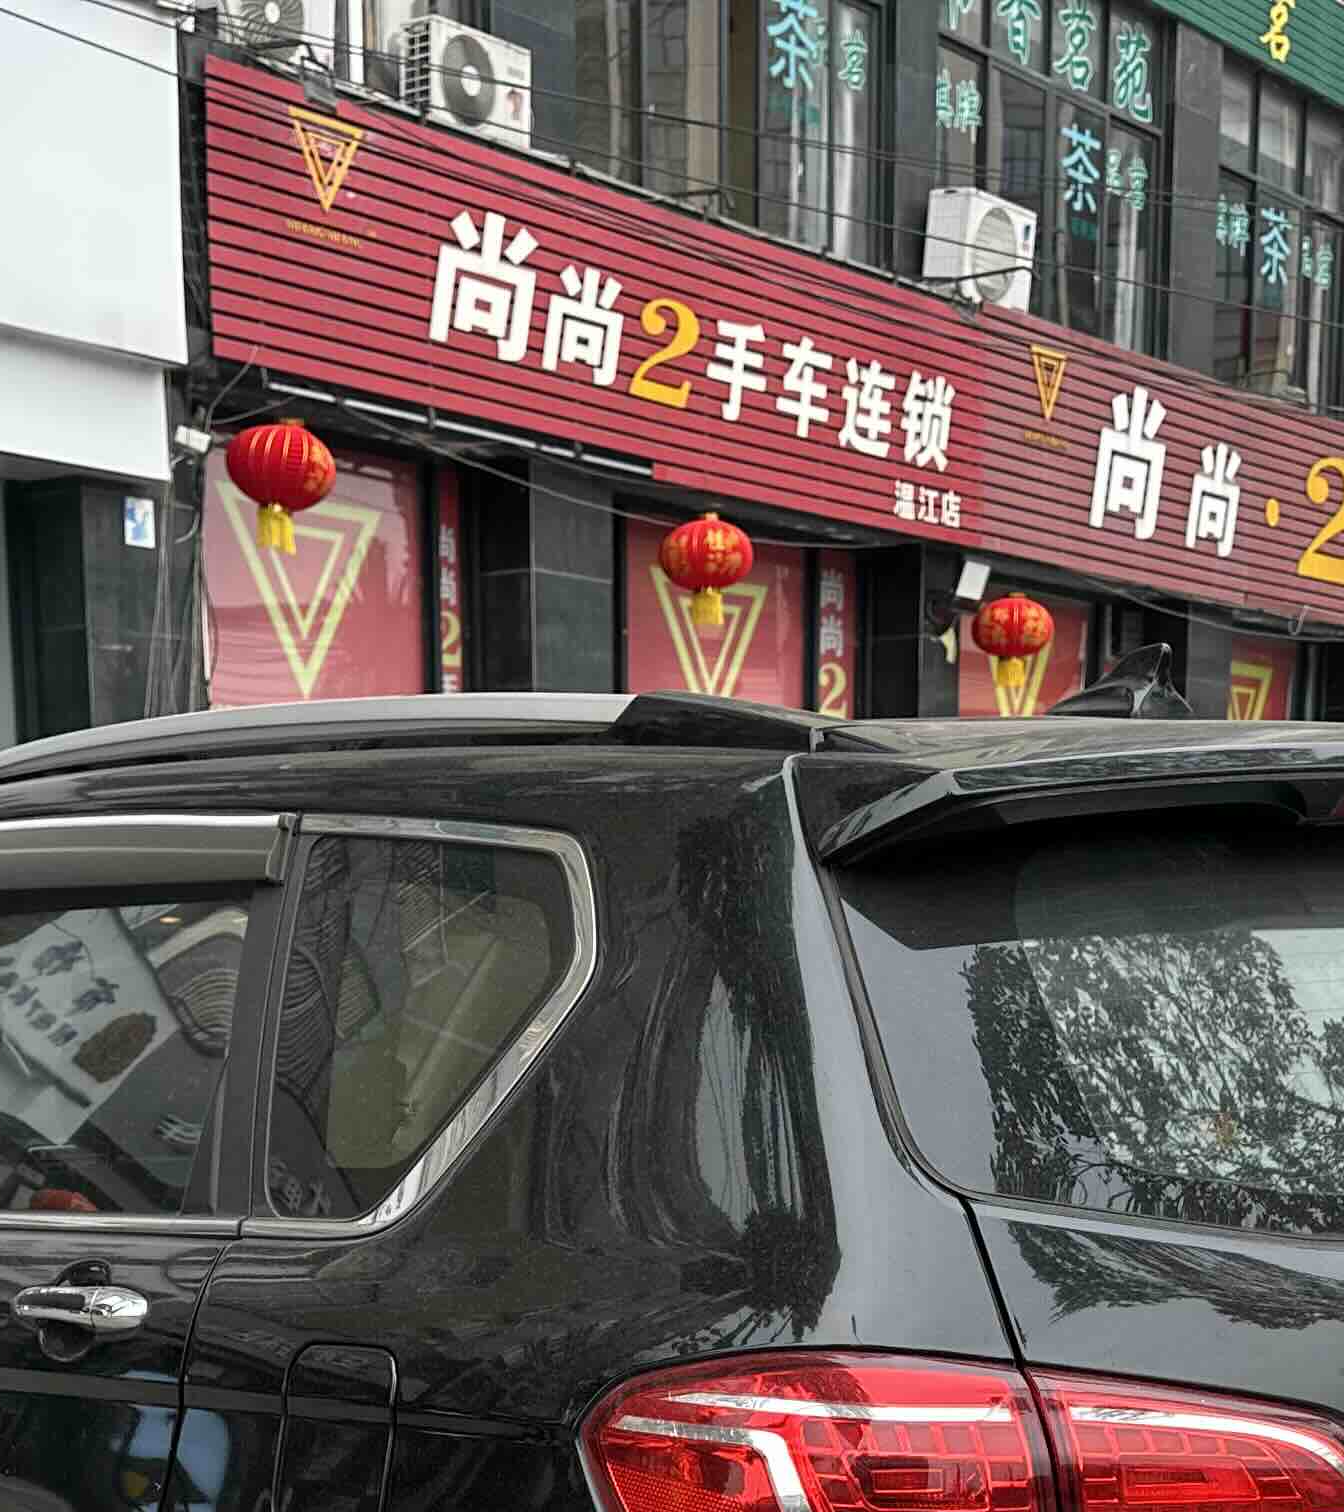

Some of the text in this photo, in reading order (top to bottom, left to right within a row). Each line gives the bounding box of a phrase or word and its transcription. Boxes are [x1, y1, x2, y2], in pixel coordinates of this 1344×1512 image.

[943, 0, 1153, 123] 香茗苑
[1060, 123, 1102, 214] 茶
[1260, 207, 1293, 286] 茶
[429, 209, 955, 472] 尚尚2手车连锁
[893, 480, 961, 529] 温江店
